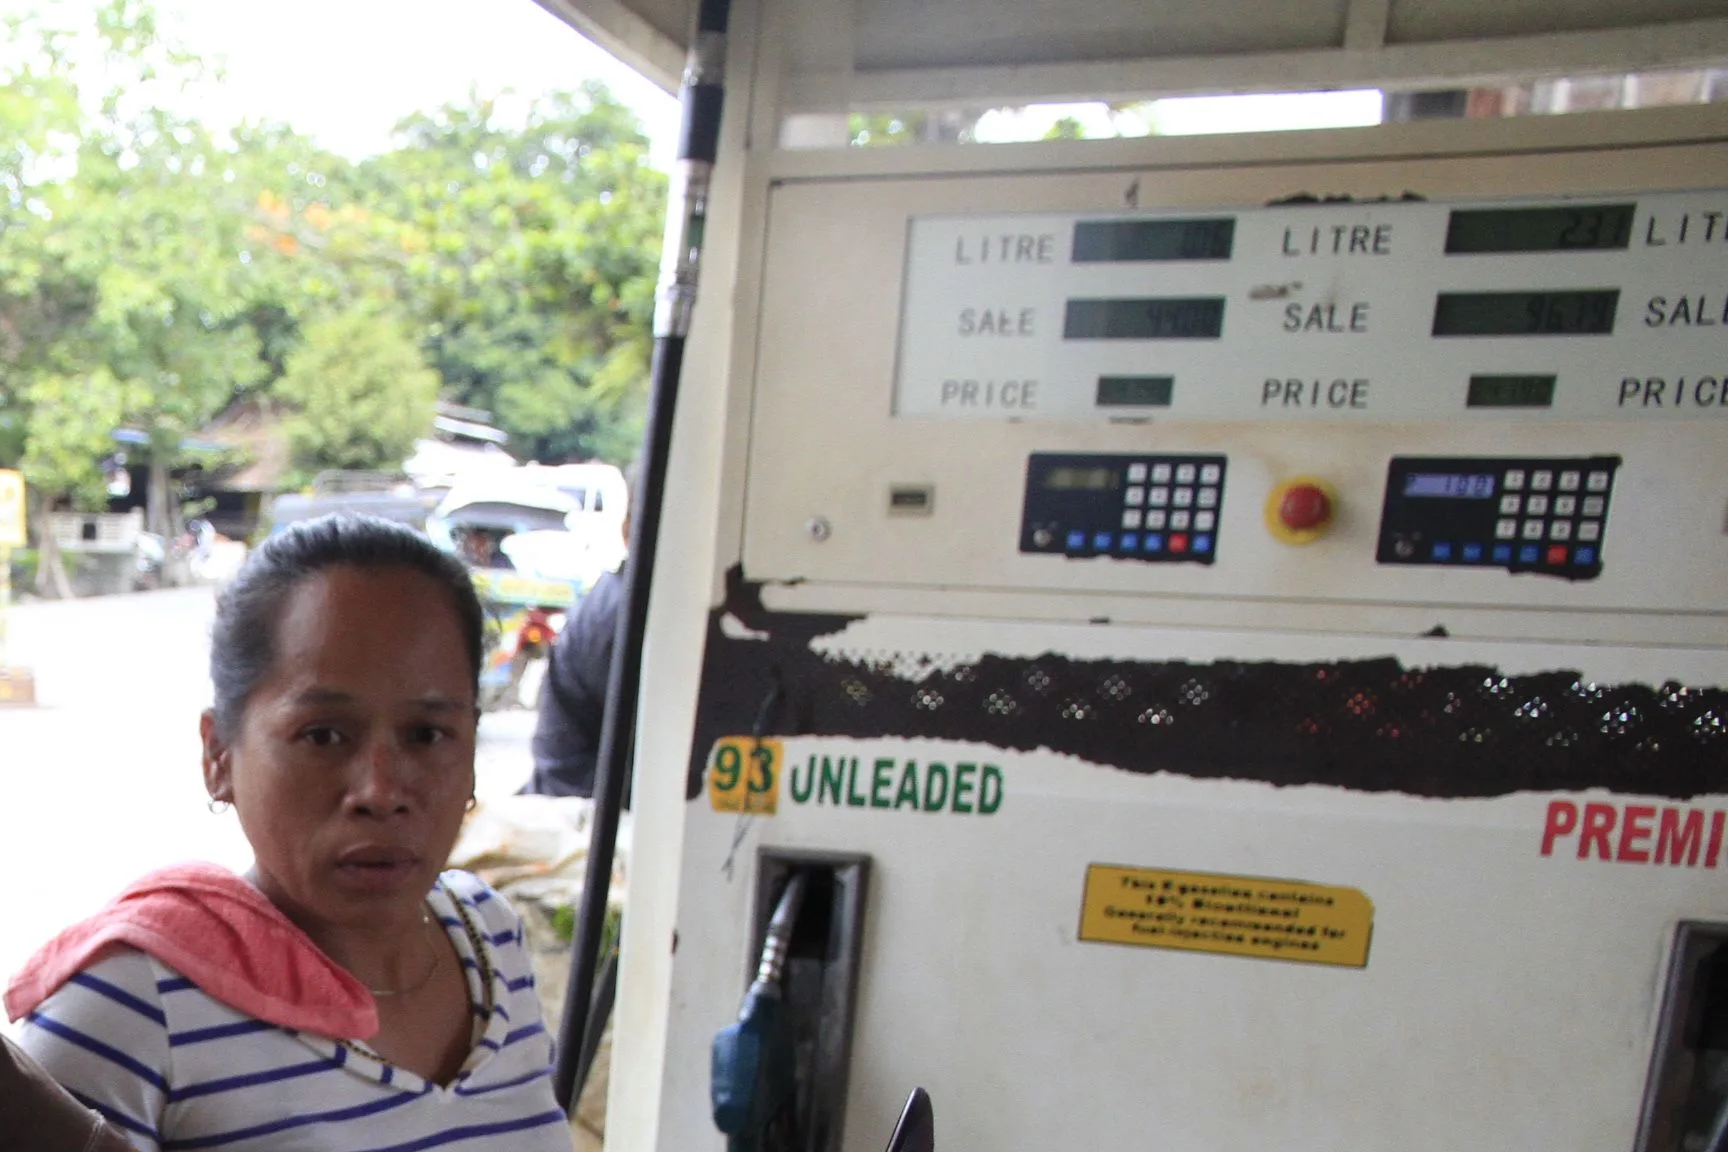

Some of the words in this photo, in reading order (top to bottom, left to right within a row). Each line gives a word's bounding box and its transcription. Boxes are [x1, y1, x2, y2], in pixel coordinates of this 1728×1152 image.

[1282, 223, 1393, 257] LITRE
[1646, 211, 1728, 247] LIT
[954, 234, 1056, 265] LITRE
[958, 306, 1035, 338] SALE
[1283, 301, 1370, 334] SALE
[1644, 295, 1728, 328] SAL
[940, 378, 1038, 408] PRICE
[1261, 378, 1370, 409] PRICE
[713, 744, 775, 794] 93
[790, 754, 1004, 815] UNLEADED
[1540, 799, 1728, 870] PREMI
